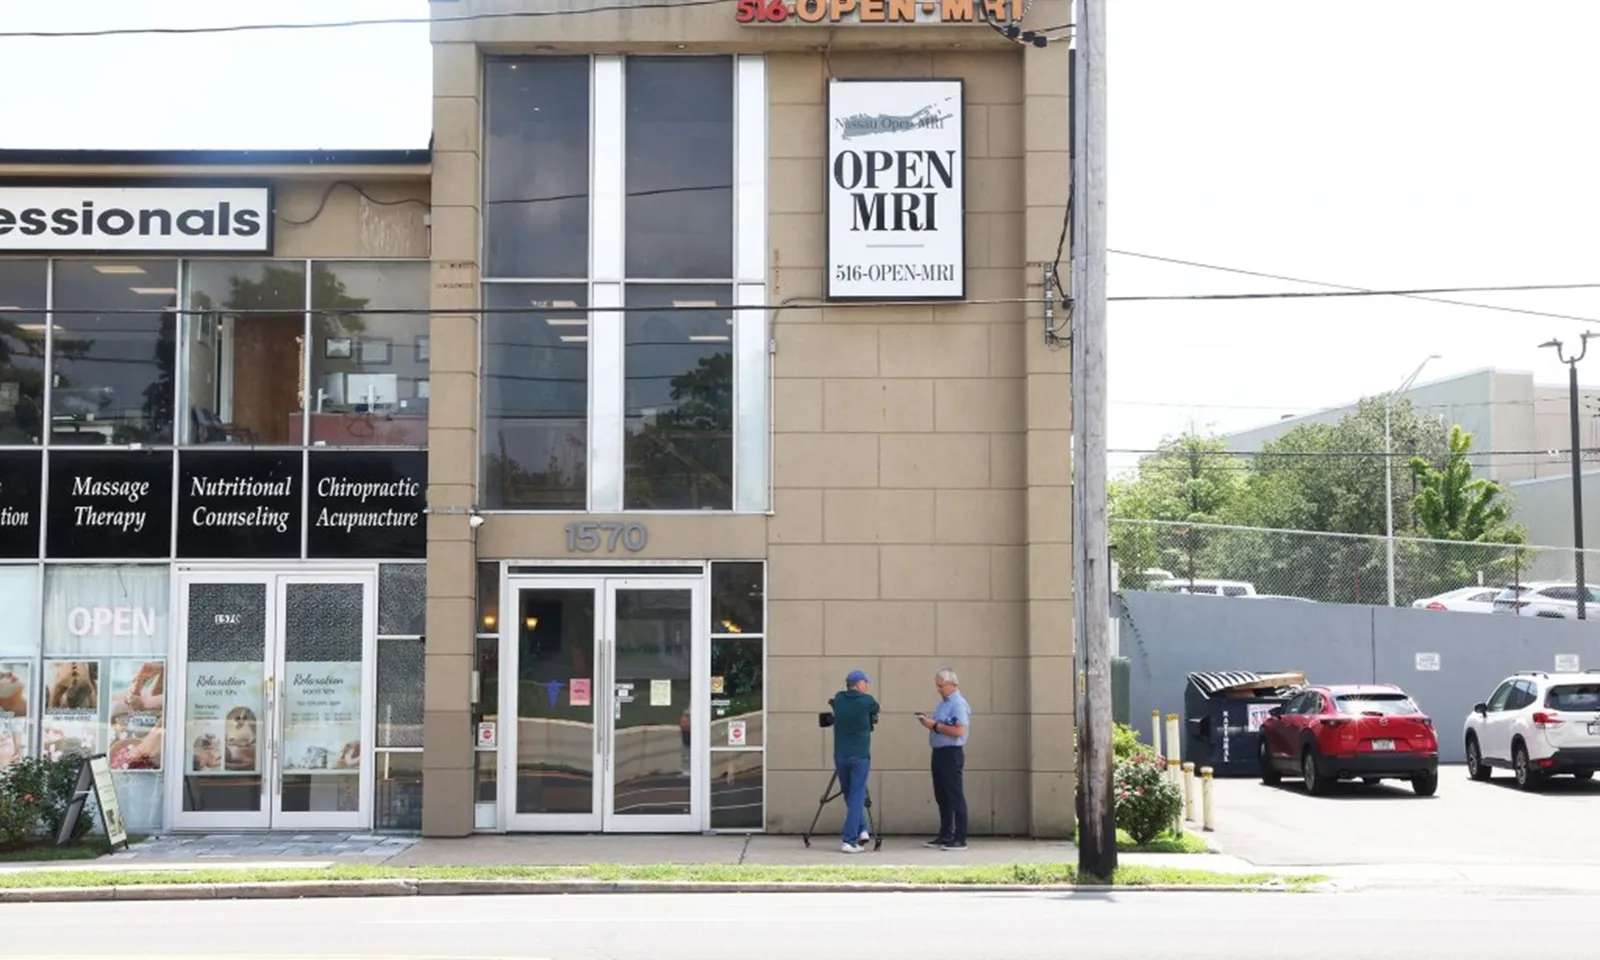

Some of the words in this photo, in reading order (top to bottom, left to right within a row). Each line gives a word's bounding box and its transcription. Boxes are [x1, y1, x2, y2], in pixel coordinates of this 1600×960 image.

[834, 150, 956, 190] OPEN
[850, 192, 938, 231] MRI
[835, 264, 955, 283] 516-OPEN-MRI
[72, 476, 149, 503] Massage
[191, 476, 292, 497] Nutritional
[317, 478, 419, 502] Chiropractic
[74, 506, 147, 532] Therapy
[192, 505, 290, 532] Counseling
[316, 508, 418, 532] Acupuncture
[565, 522, 648, 552] 1570
[67, 607, 155, 637] OPEN
